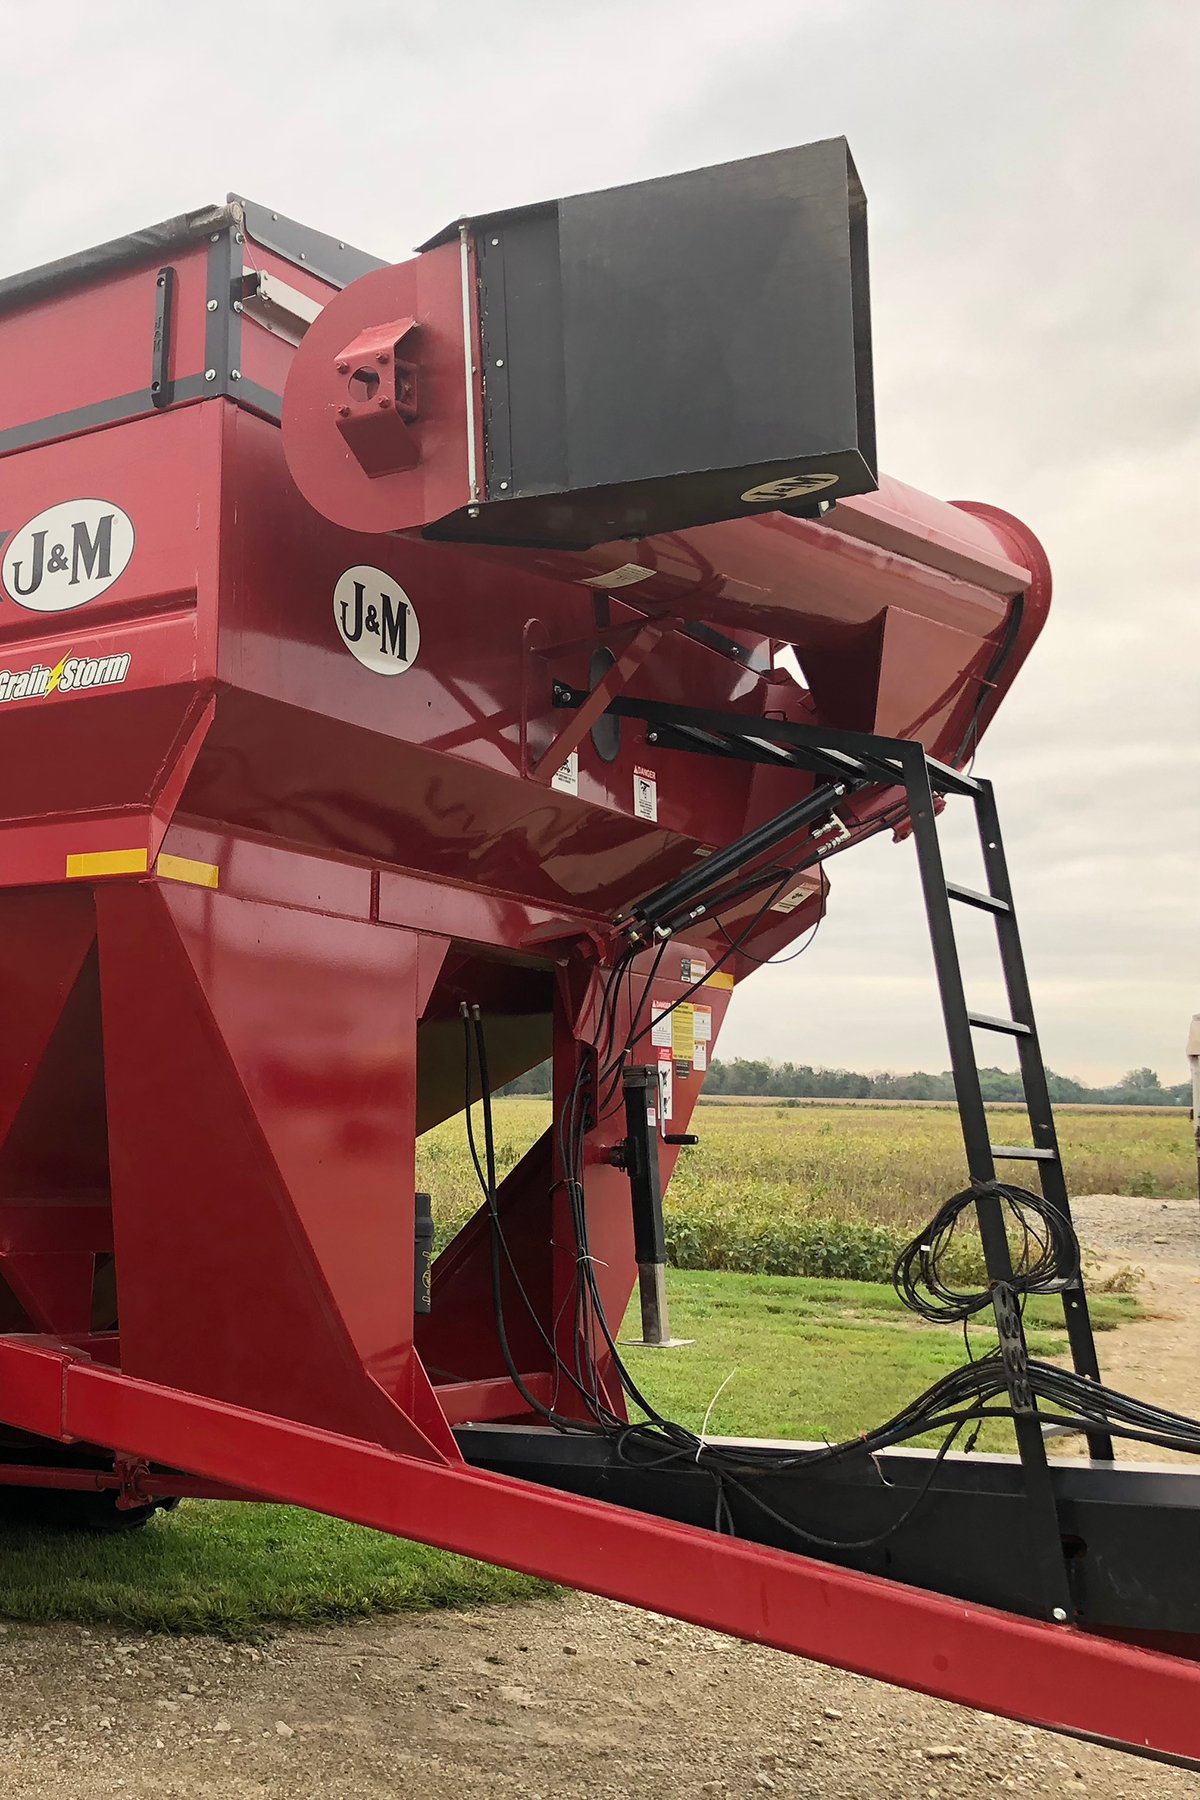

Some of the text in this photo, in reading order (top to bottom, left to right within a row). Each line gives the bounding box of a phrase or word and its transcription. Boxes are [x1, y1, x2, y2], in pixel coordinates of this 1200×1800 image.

[753, 476, 835, 501] J&M
[12, 514, 115, 596] J&M
[340, 580, 408, 662] J&M
[59, 653, 131, 692] Storm
